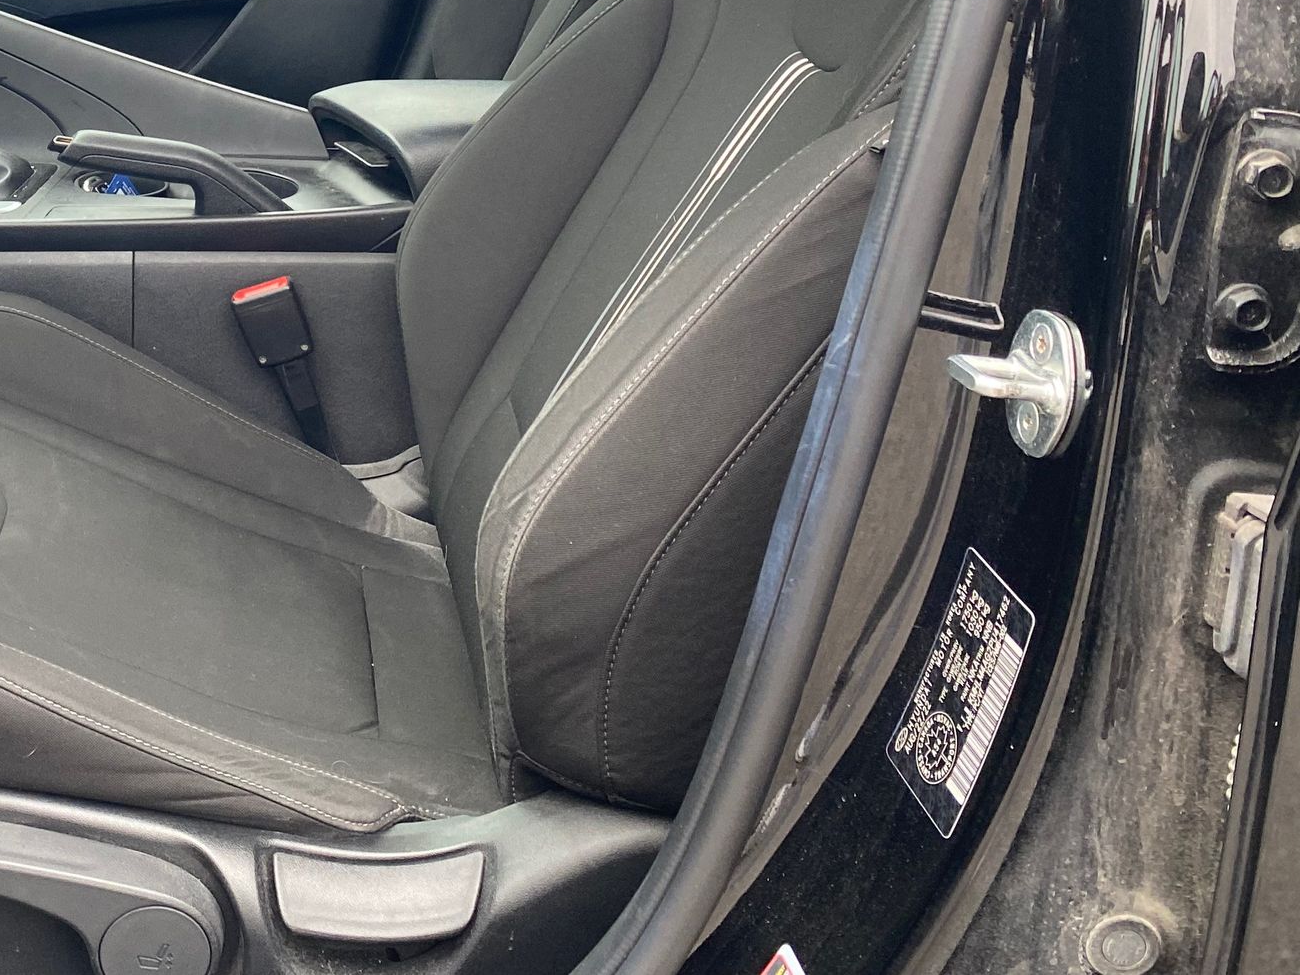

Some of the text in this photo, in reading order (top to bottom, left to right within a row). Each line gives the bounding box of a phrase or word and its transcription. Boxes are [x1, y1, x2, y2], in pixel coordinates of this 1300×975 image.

[960, 589, 979, 629] 1750 kg
[973, 603, 991, 638] 950 kg
[975, 596, 985, 611] kg
[907, 561, 976, 731] HYUNDAI MOTOR COMPANY
[938, 686, 948, 703] TYPE
[904, 699, 931, 754] AUG/22/22
[934, 737, 956, 781] TRANSPORT
